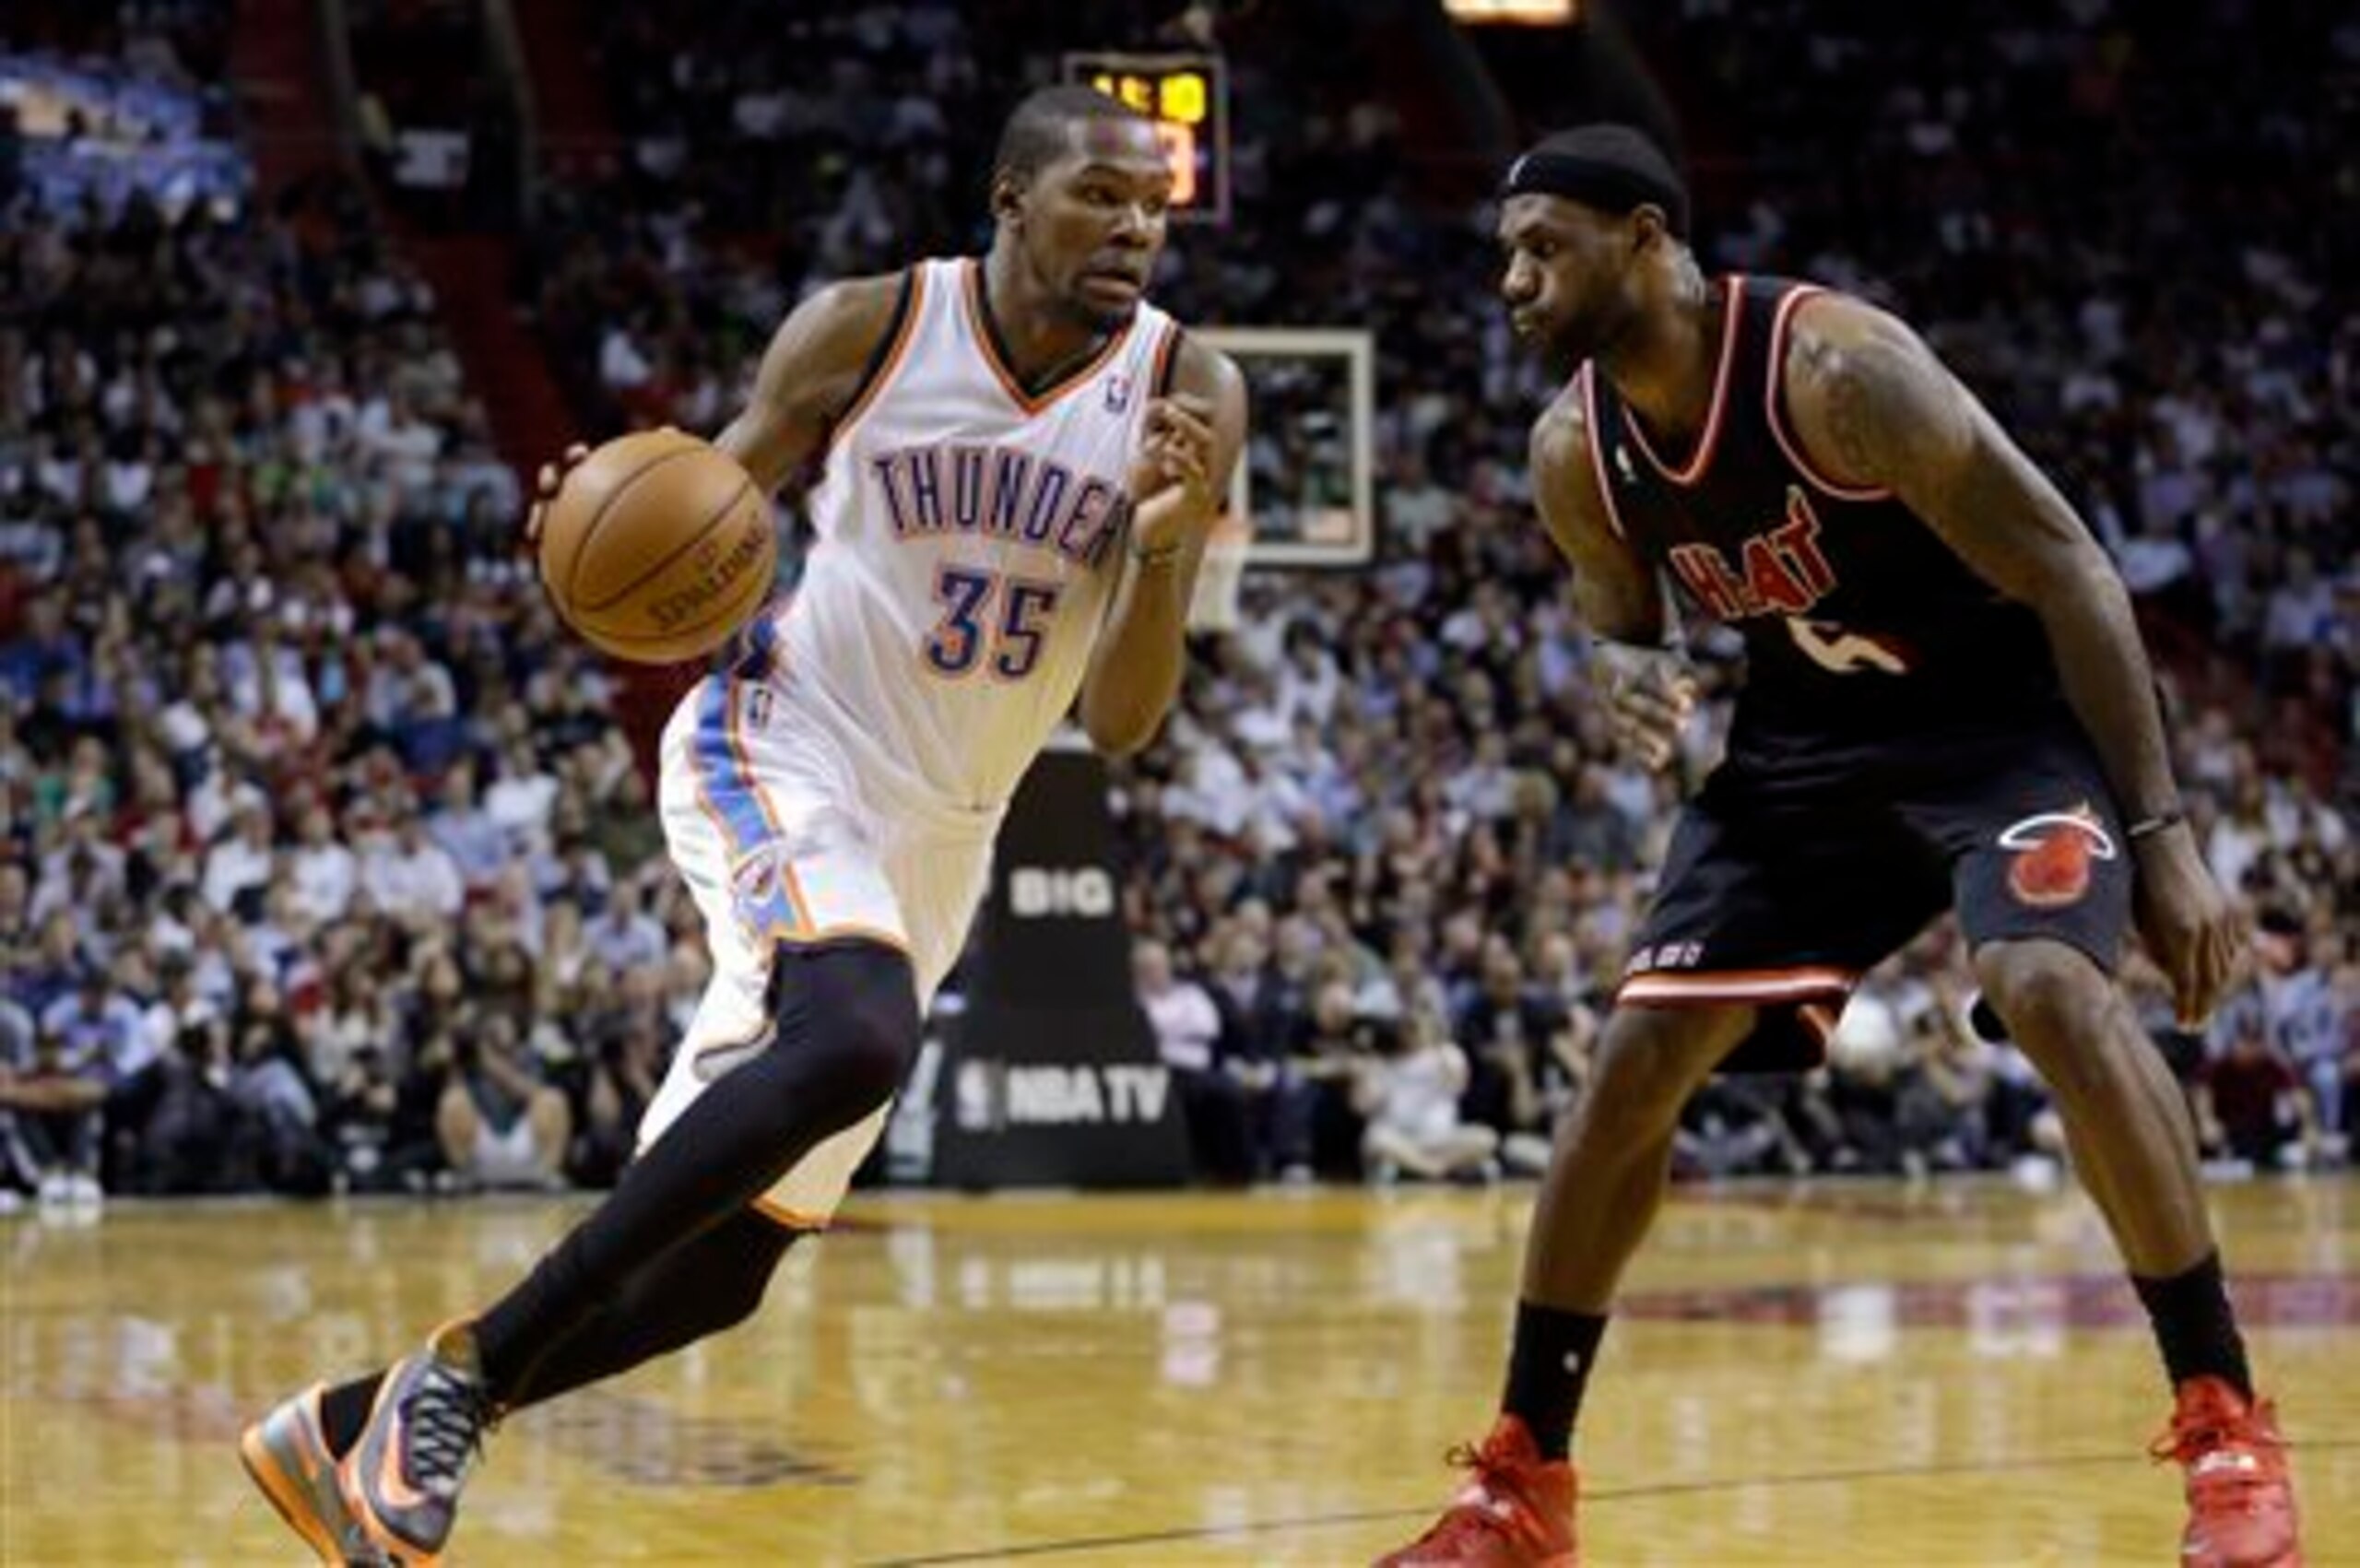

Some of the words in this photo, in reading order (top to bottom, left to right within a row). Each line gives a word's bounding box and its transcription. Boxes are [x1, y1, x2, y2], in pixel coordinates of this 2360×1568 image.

[872, 446, 1127, 568] THUNDER
[1670, 484, 1837, 619] HAT
[926, 564, 1059, 680] 35
[1009, 866, 1114, 917] BIG
[1007, 1064, 1103, 1124] NBA
[1103, 1064, 1170, 1124] TV
